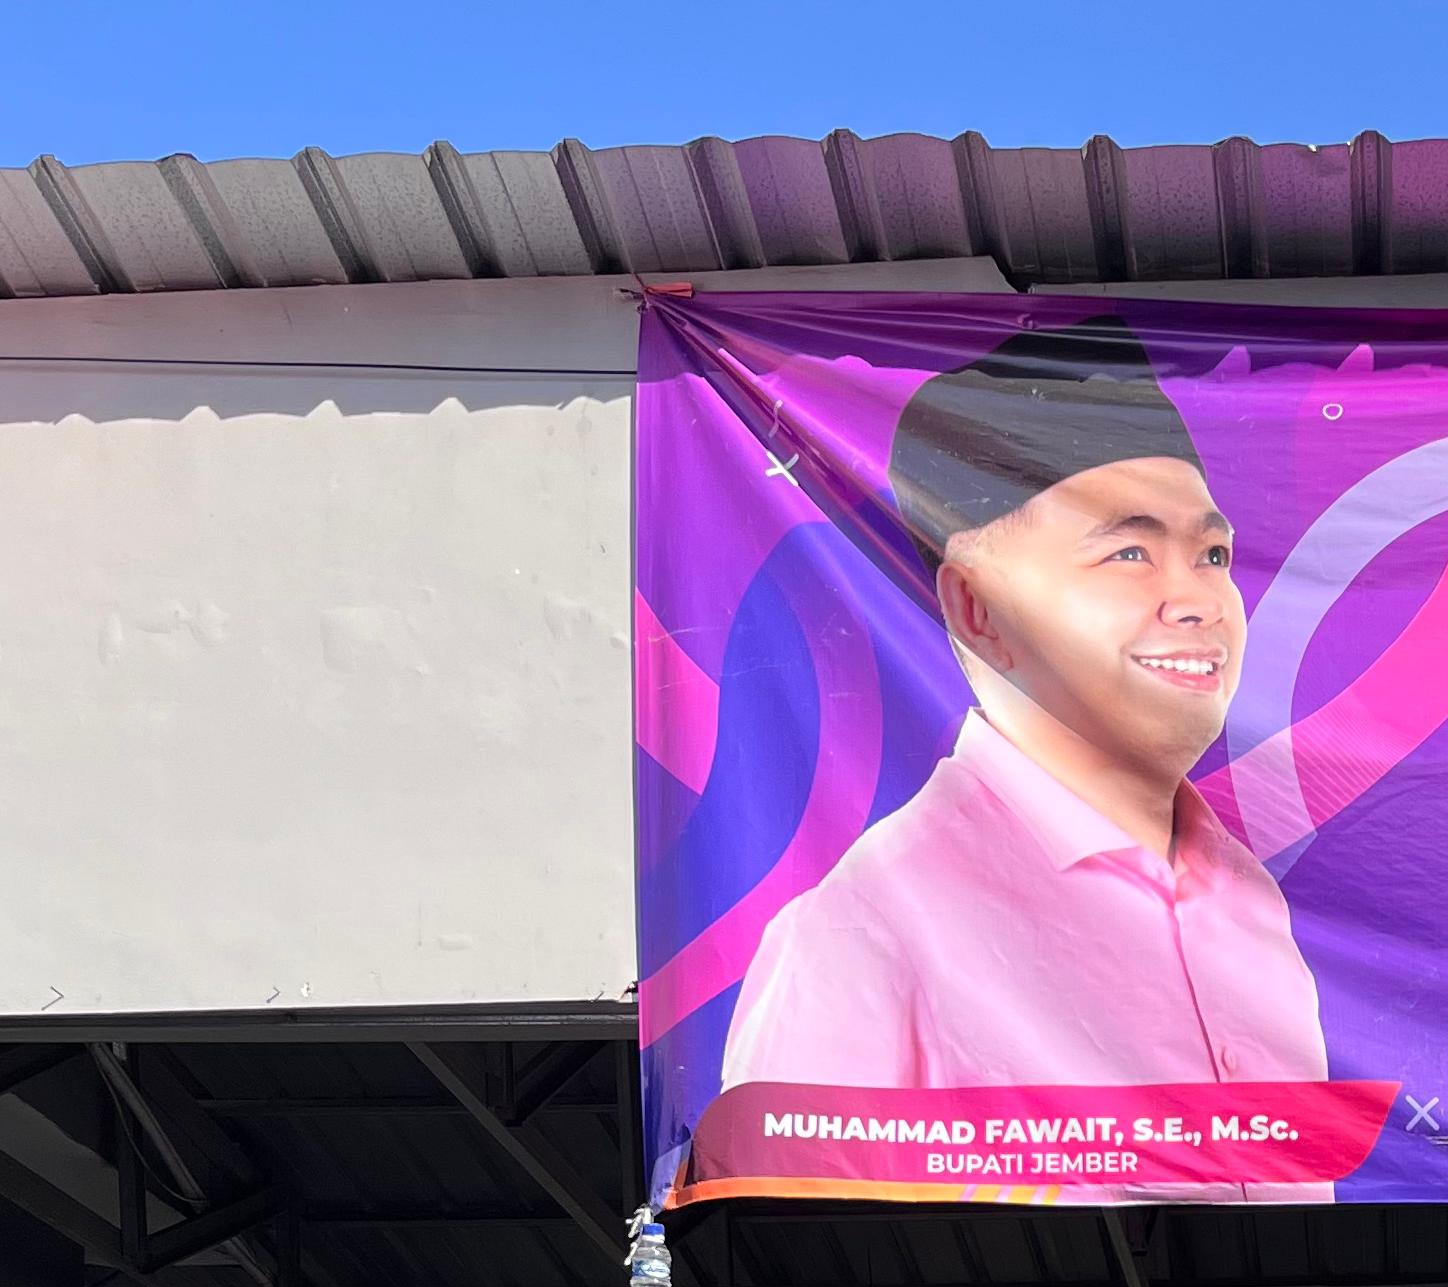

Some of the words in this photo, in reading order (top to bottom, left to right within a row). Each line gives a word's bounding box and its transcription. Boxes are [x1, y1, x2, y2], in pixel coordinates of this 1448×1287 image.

[763, 1112, 976, 1144] MUHAMMAD
[985, 1116, 1124, 1147] FAWAIT,
[1132, 1116, 1202, 1144] S.E.,
[1211, 1114, 1299, 1142] M.Sc.
[927, 1152, 1023, 1174] BUPATI
[1031, 1151, 1138, 1174] JEMBER
